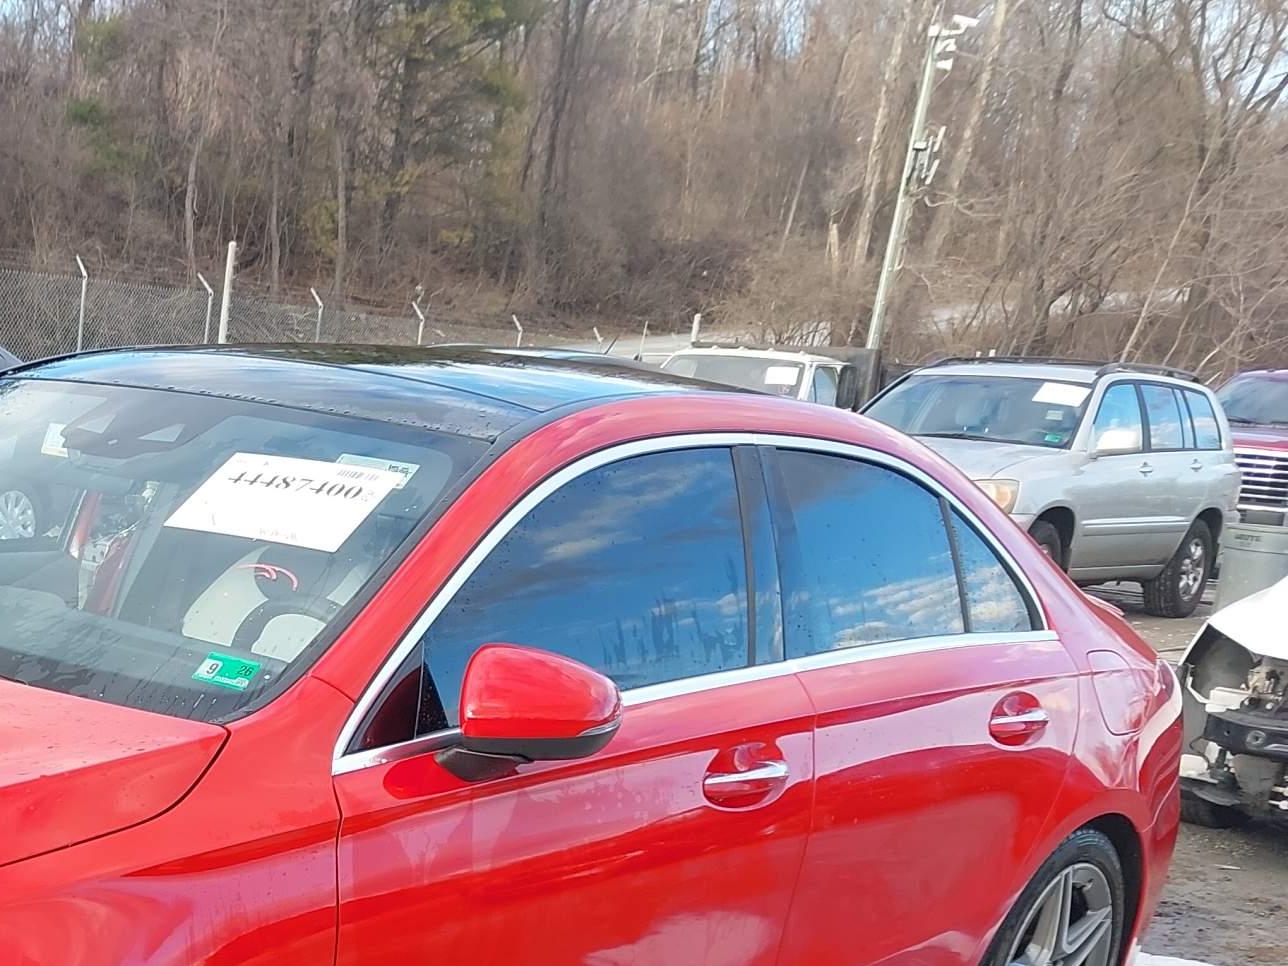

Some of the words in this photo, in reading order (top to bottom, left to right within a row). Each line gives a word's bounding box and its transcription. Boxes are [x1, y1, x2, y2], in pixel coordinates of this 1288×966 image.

[227, 471, 363, 500] 44487400
[206, 663, 220, 675] 9
[237, 664, 255, 677] 26
